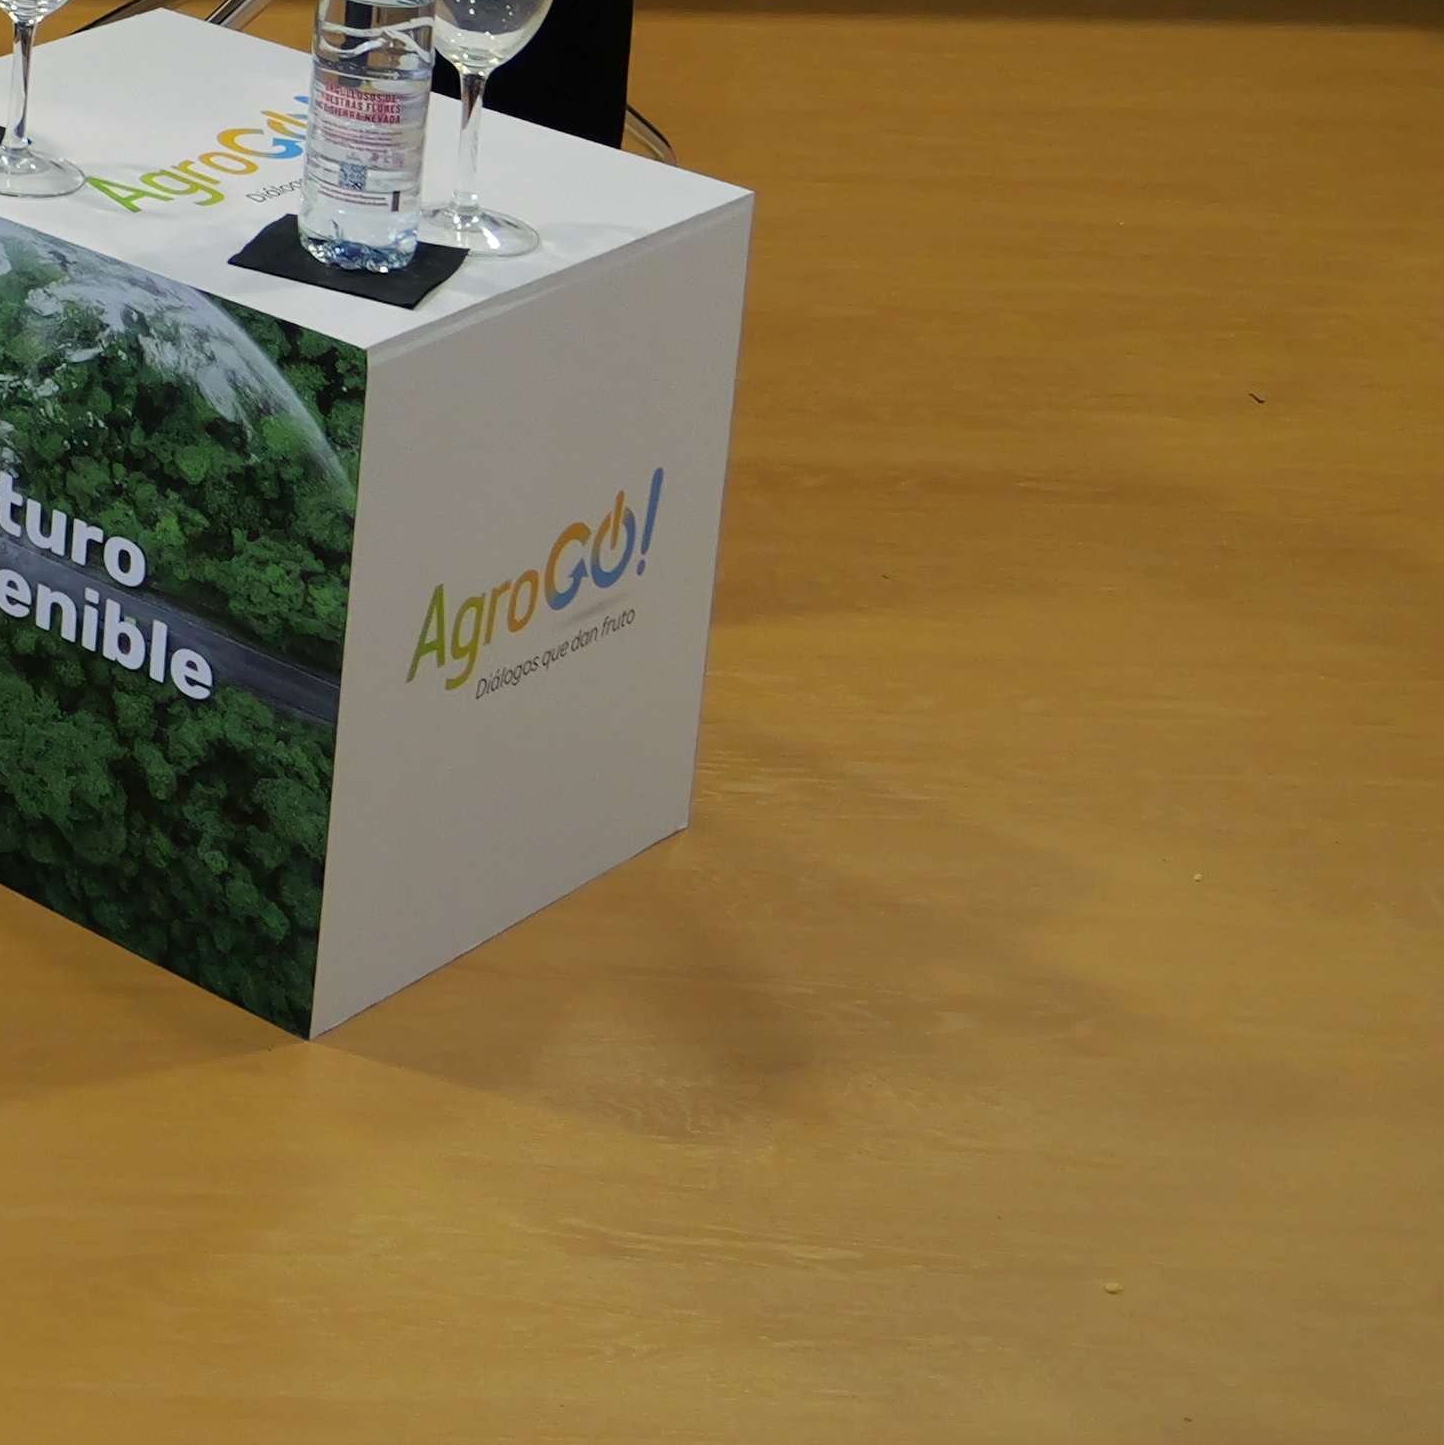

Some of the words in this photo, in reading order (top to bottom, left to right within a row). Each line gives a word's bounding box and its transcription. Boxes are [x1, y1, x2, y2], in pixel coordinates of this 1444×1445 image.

[475, 656, 540, 700] Diálogos
[541, 640, 569, 670] que
[570, 627, 598, 653] dan
[600, 609, 636, 639] fruto
